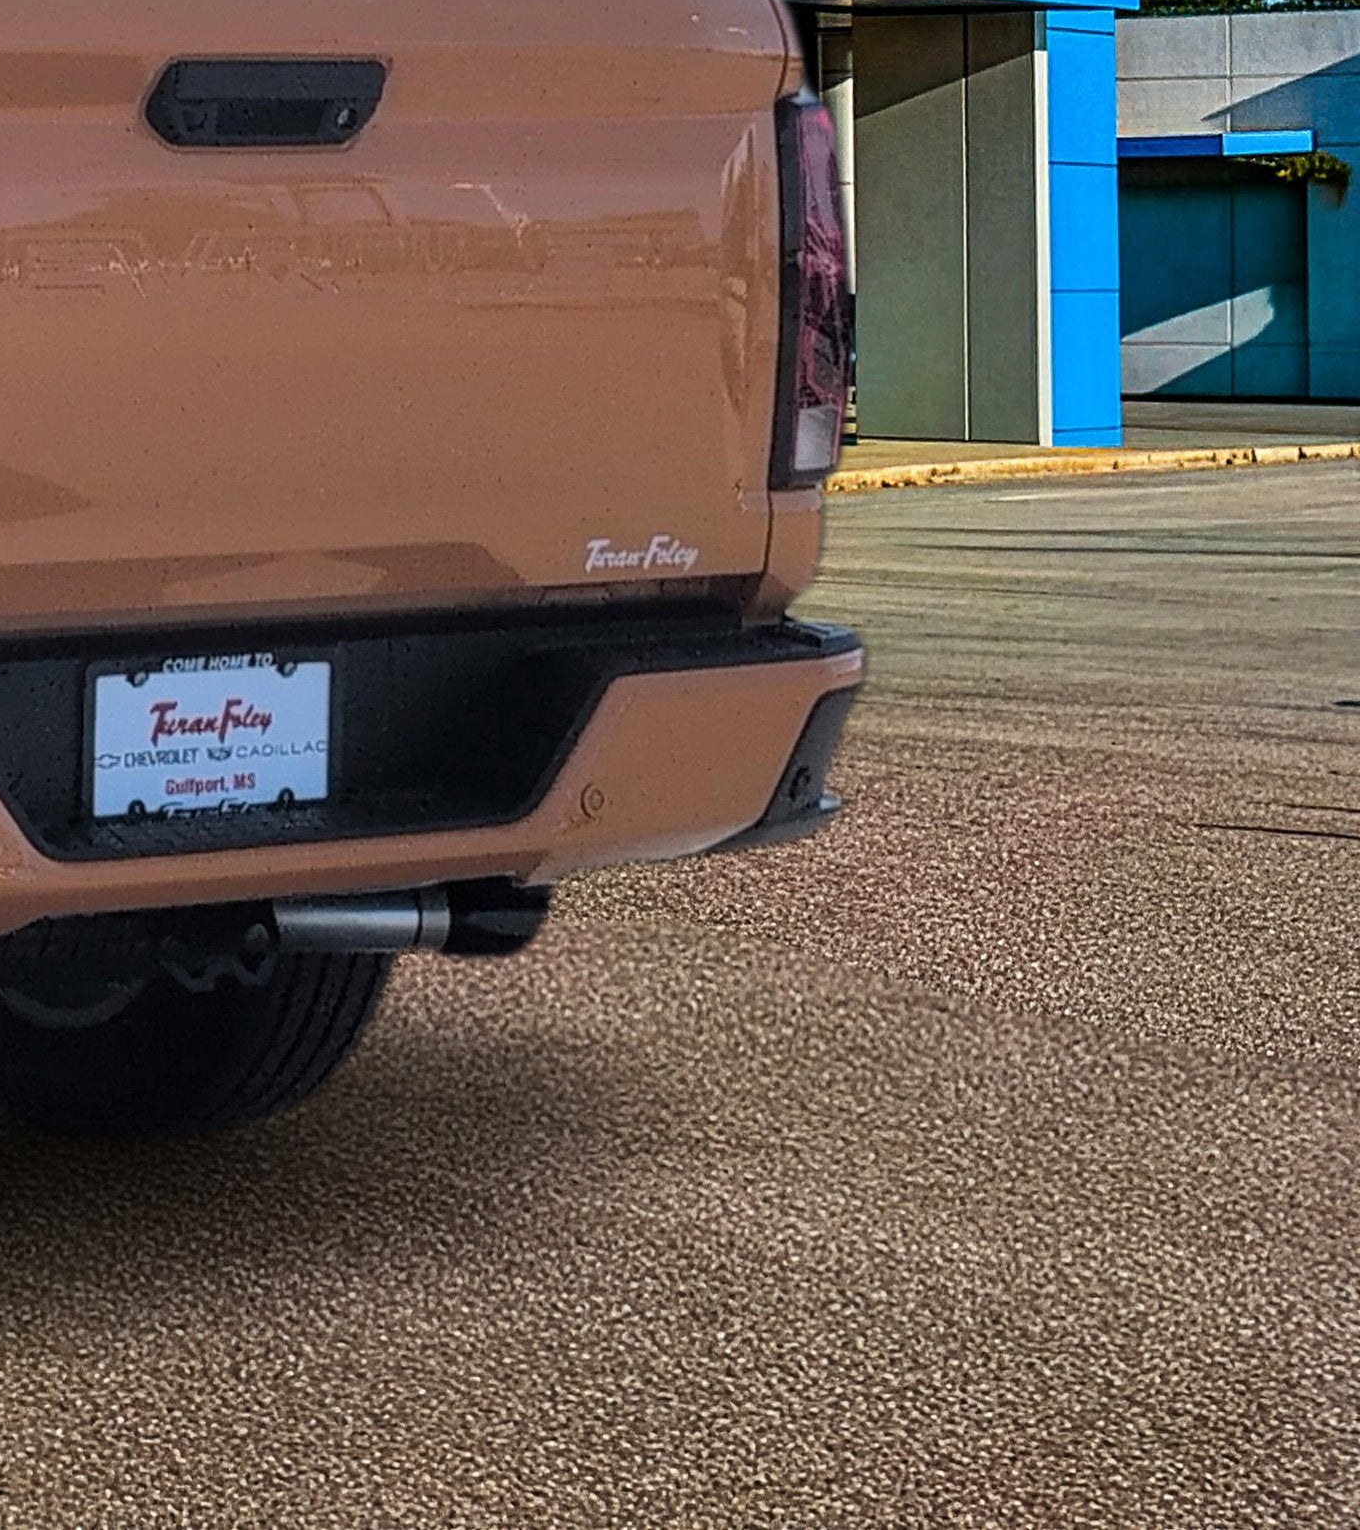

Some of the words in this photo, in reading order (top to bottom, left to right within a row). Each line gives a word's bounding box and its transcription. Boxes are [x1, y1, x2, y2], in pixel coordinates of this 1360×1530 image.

[162, 656, 206, 673] COME
[208, 654, 252, 671] HOME
[254, 651, 274, 668] TO
[123, 747, 200, 768] CHEVROLET
[236, 739, 328, 760] CADILLAC
[164, 776, 230, 796] Gulfport,
[233, 773, 256, 791] MS
